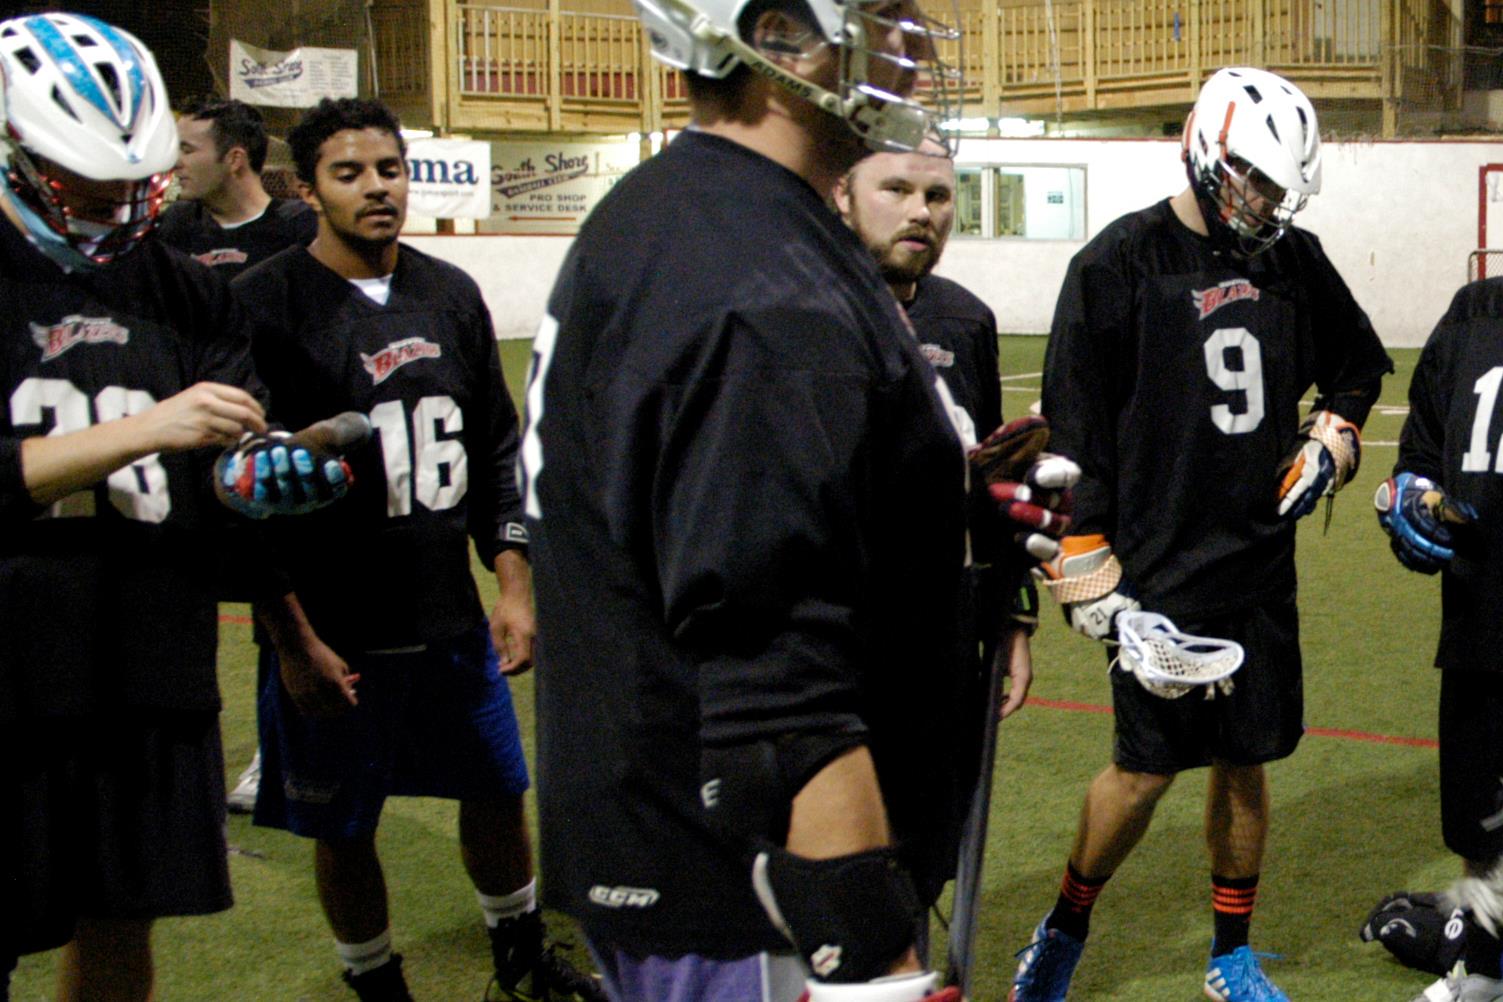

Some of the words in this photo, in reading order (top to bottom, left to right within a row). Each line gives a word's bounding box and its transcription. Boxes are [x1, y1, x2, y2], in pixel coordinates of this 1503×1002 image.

[753, 60, 815, 98] ADAMS
[545, 152, 588, 173] Shore
[505, 204, 552, 212] SERVICE
[557, 204, 587, 212] DESK
[529, 194, 552, 202] PRO
[557, 194, 587, 202] SHOP
[1203, 327, 1265, 434] 9
[369, 395, 468, 518] 16
